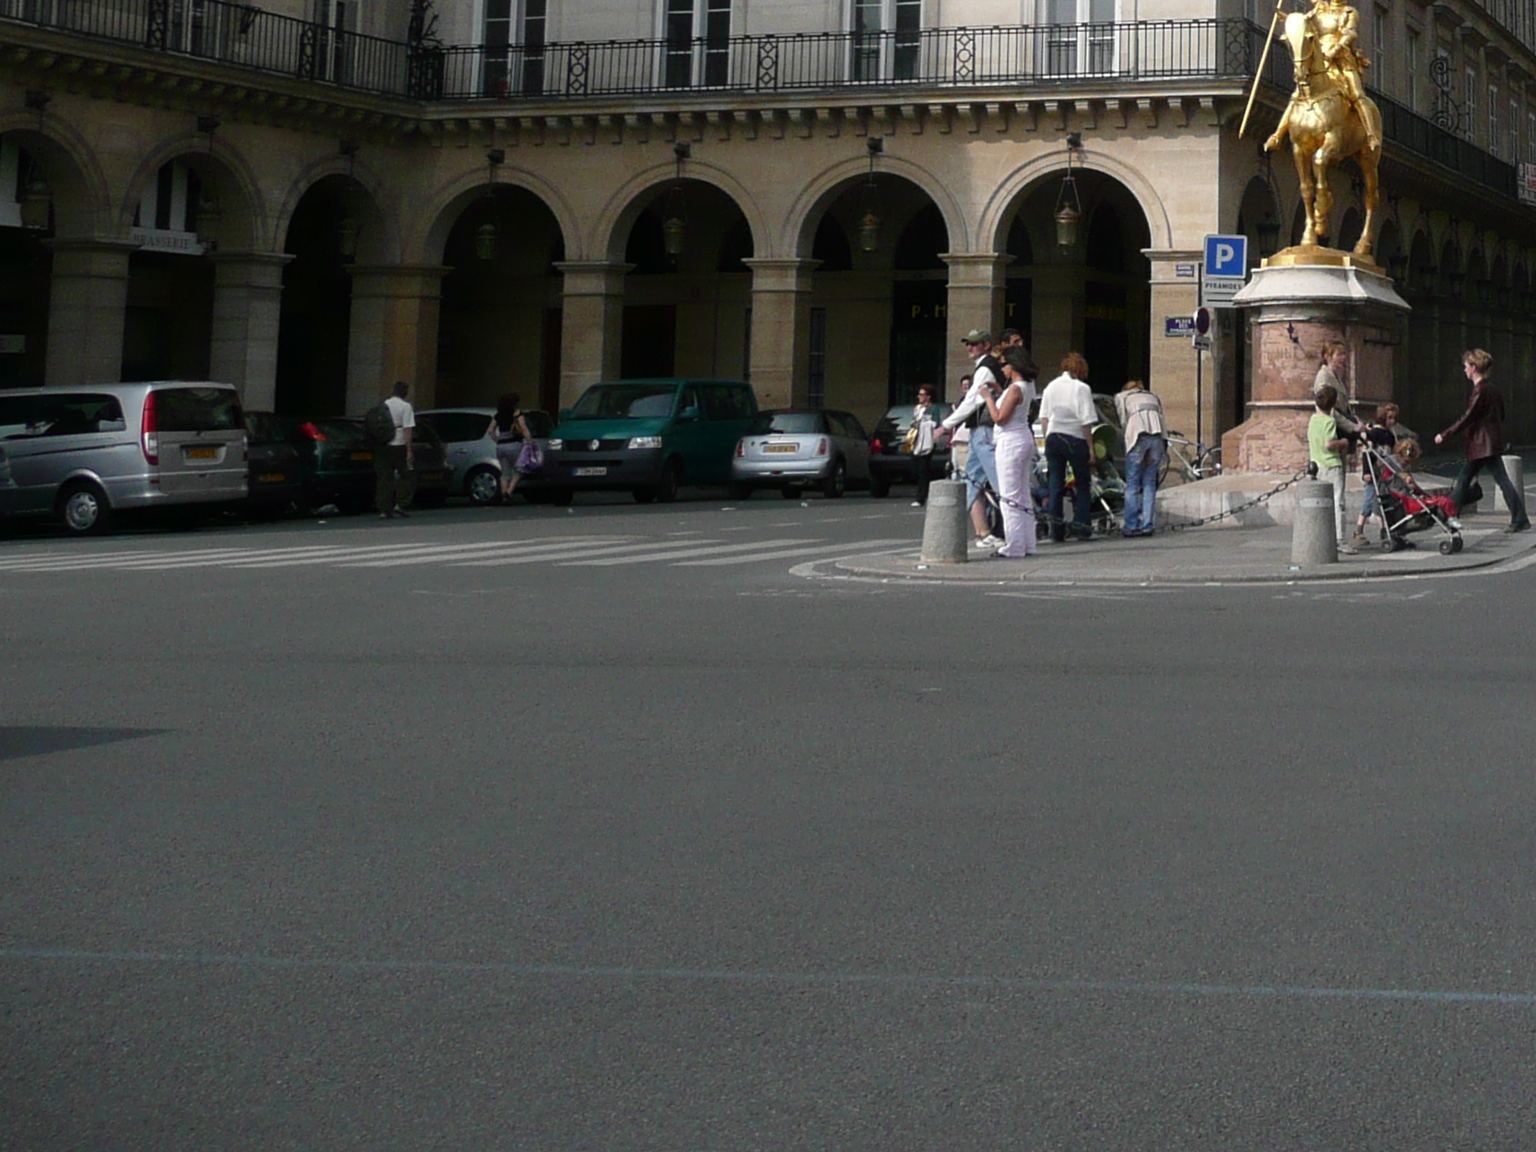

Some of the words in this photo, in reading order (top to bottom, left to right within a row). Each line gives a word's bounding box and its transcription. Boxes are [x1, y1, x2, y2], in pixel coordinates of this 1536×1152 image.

[133, 233, 189, 249] BRASSERIE
[1215, 243, 1234, 269] P
[1205, 282, 1242, 290] PYRAMIDES
